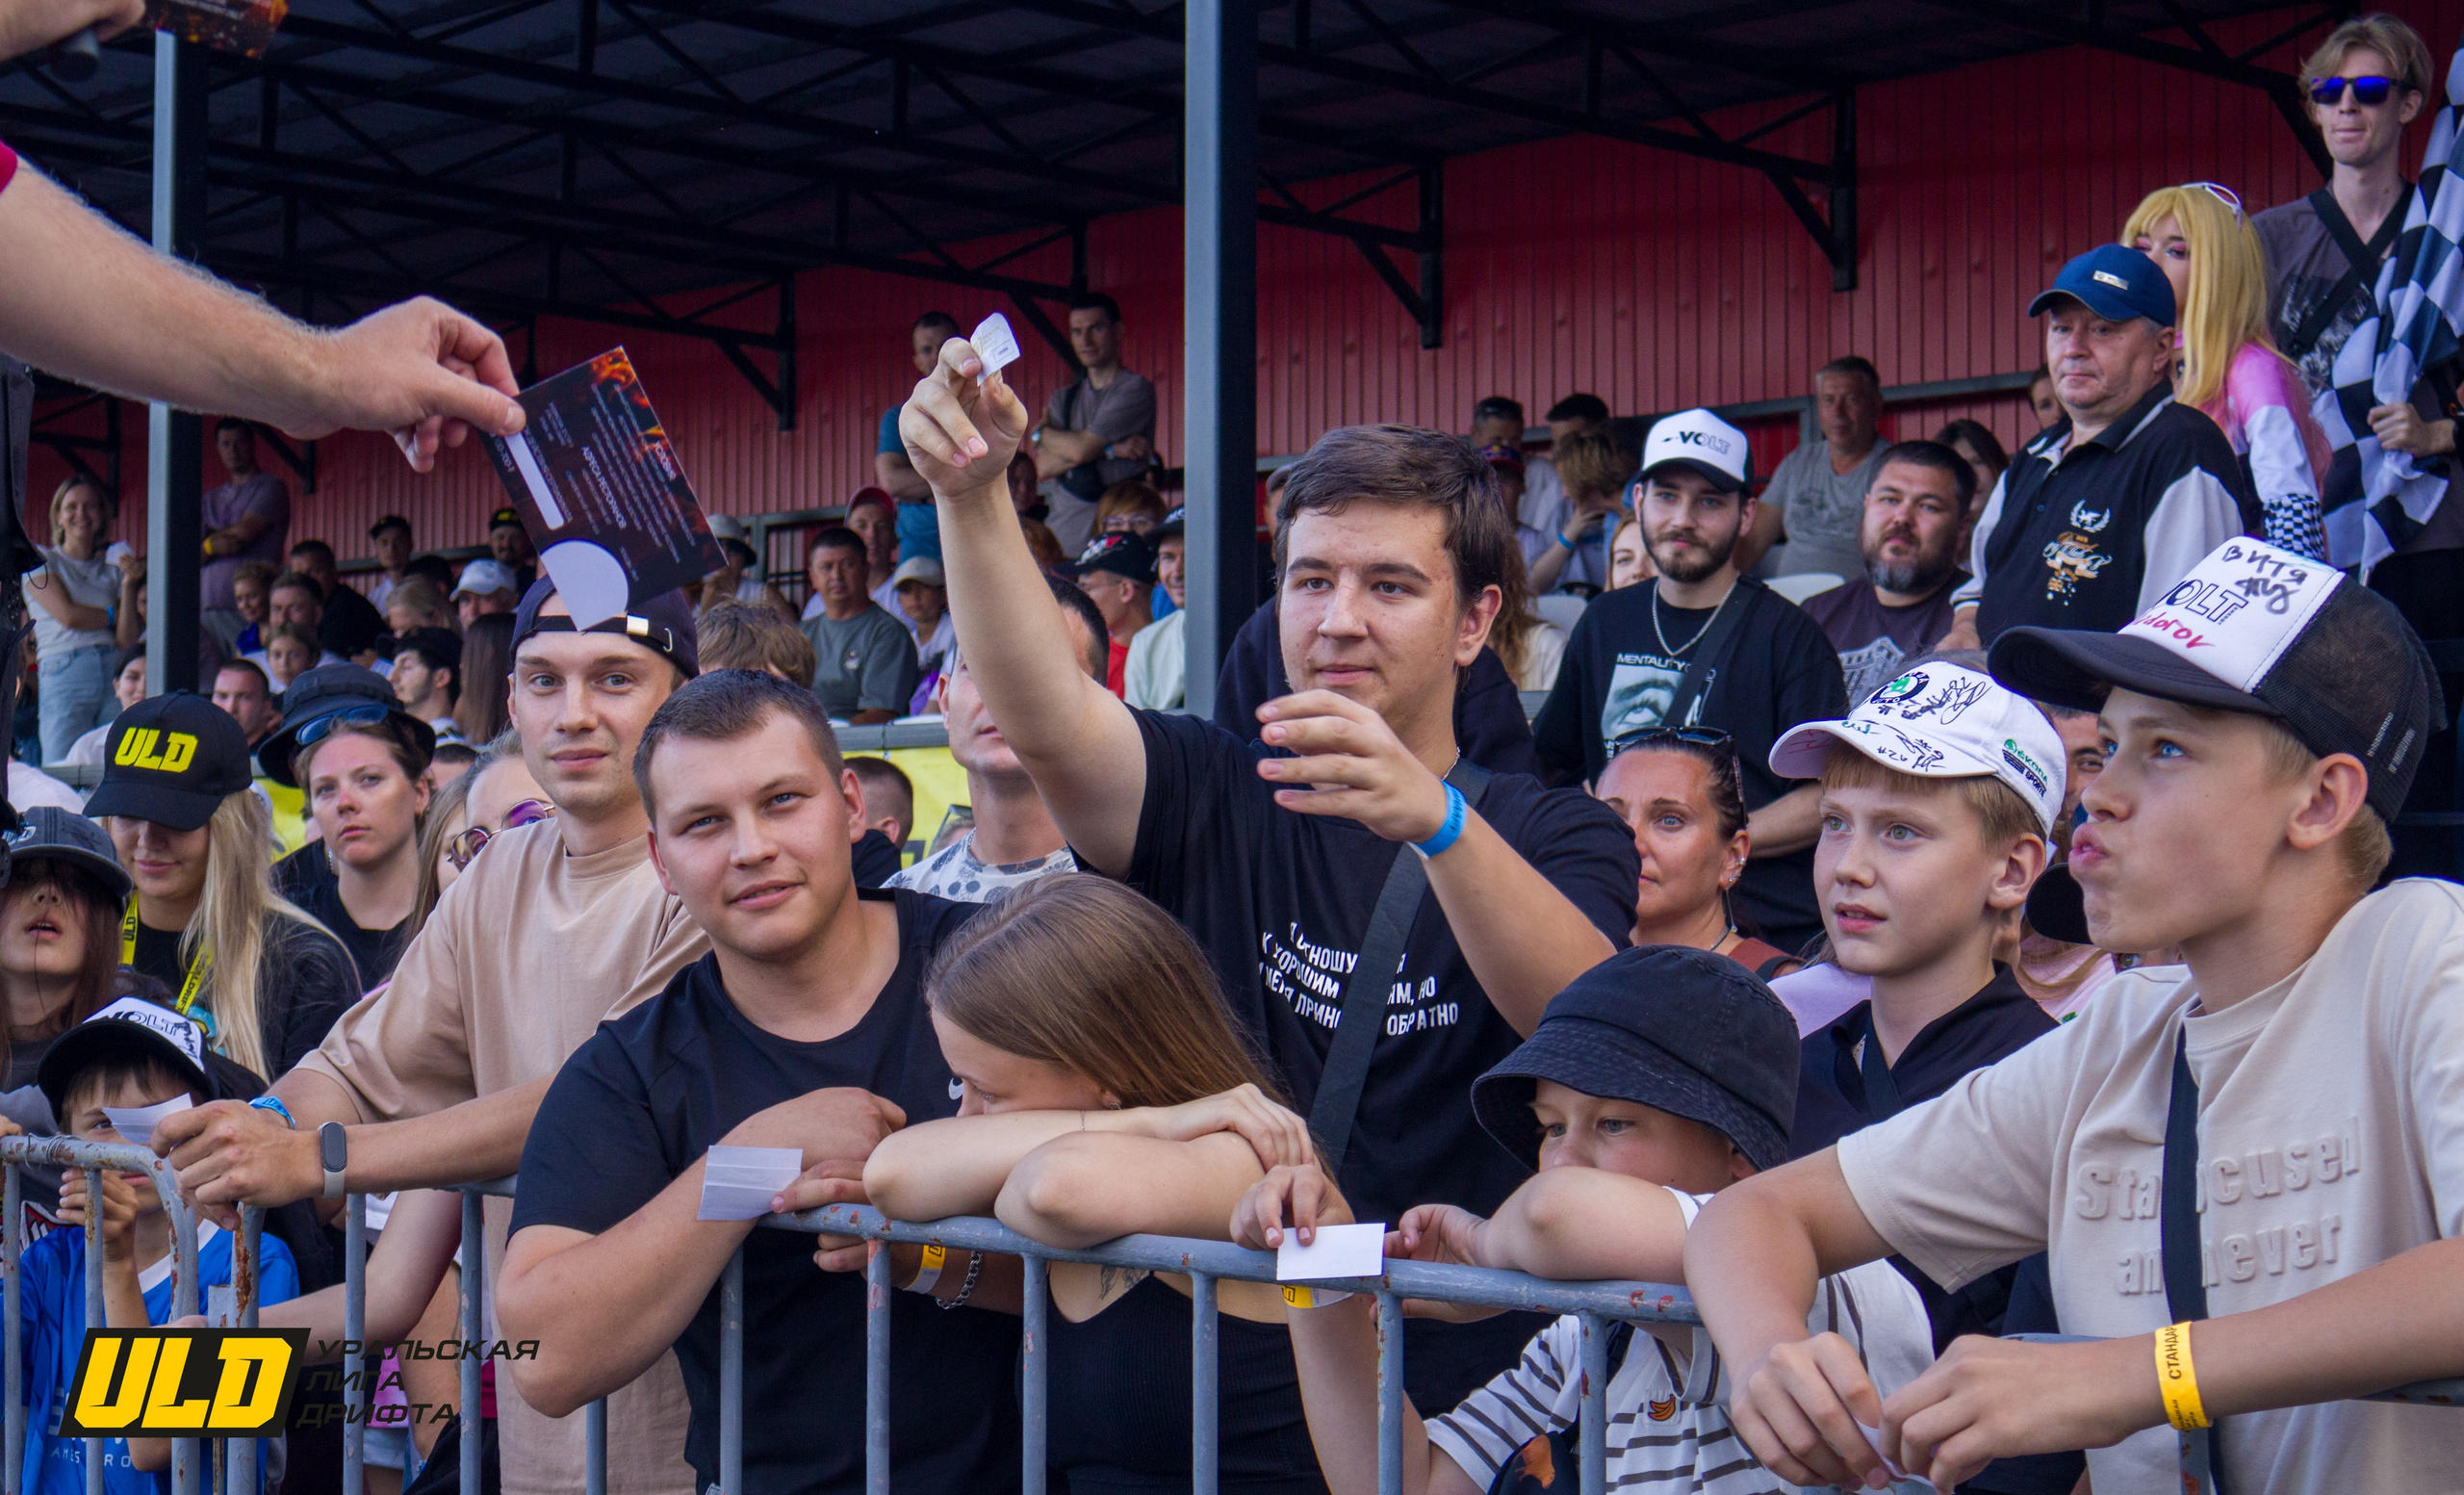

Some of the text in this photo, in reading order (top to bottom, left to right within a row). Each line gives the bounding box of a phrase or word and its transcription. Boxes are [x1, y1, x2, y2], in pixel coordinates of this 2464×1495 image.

[1680, 431, 1731, 454] VOLT
[2156, 579, 2249, 624] OLT
[115, 727, 198, 773] ULD
[122, 916, 136, 942] ULD
[1418, 975, 1437, 1001] НО
[1386, 1002, 1459, 1037] ОБРАТНО
[2075, 1161, 2162, 1221] Sta
